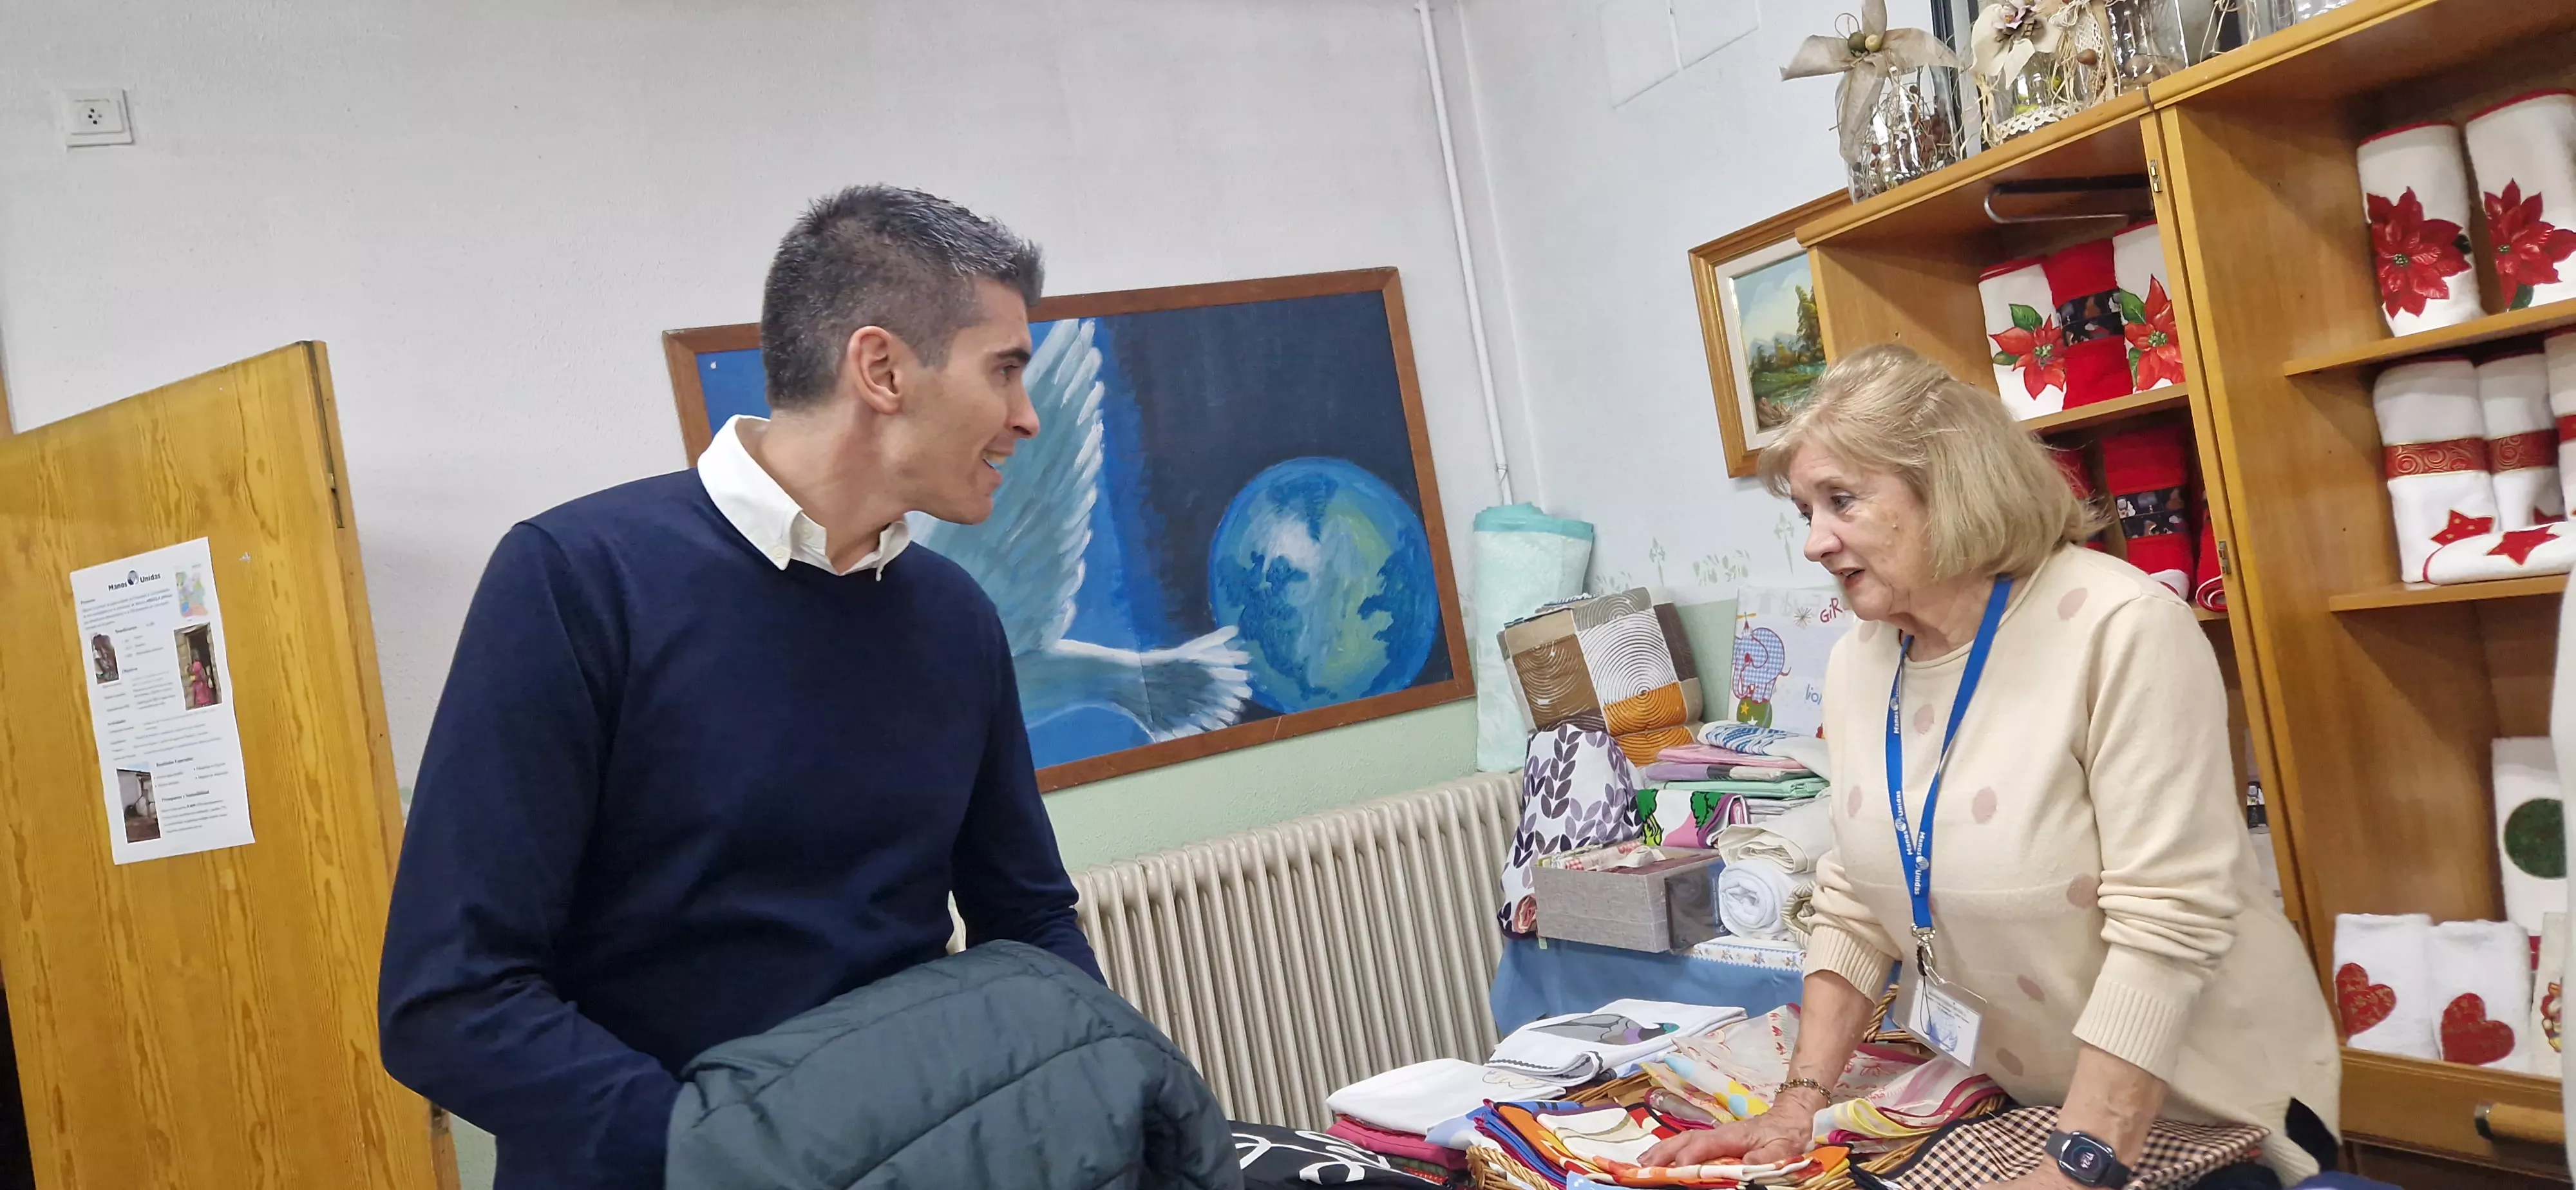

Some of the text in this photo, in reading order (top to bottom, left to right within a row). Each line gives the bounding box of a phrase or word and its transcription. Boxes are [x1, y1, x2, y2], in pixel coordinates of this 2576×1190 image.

[108, 572, 161, 592] Manos Unidas
[1904, 831, 1913, 855] Manos
[1917, 831, 1926, 856] Manos
